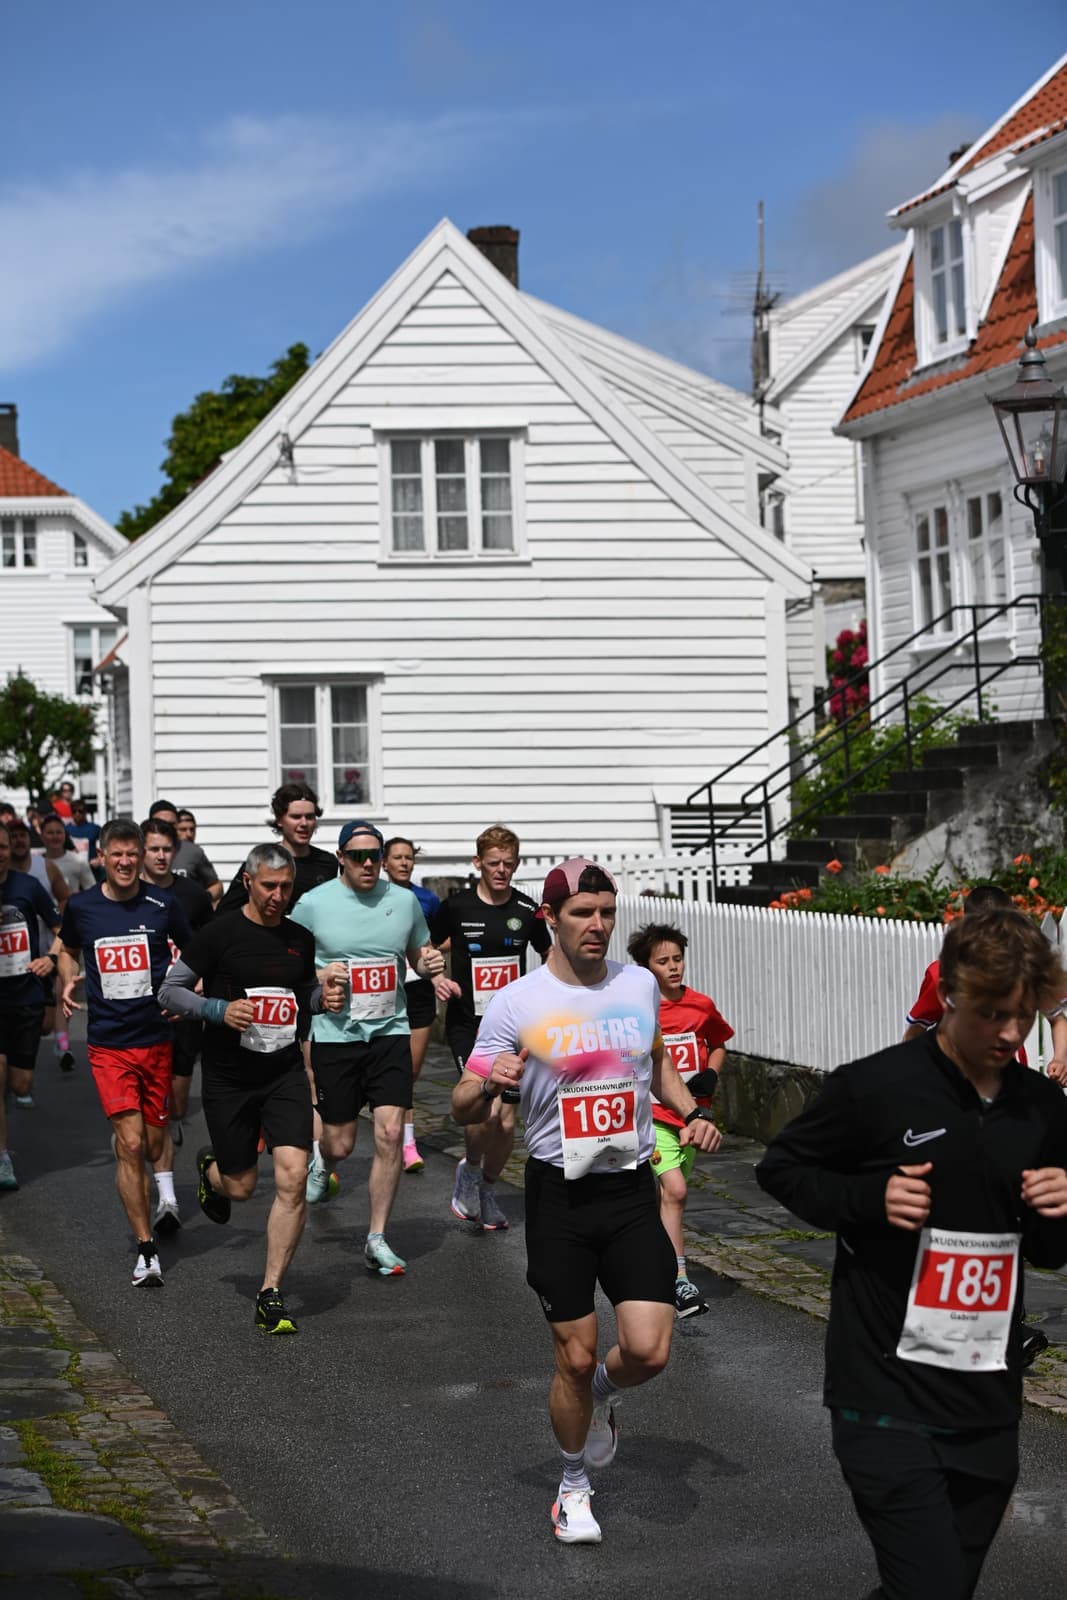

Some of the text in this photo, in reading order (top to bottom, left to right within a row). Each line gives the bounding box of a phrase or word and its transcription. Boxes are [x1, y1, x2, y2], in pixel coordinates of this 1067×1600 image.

[103, 946, 142, 970] 216
[358, 967, 389, 990] 181
[480, 966, 511, 988] 271
[255, 998, 291, 1022] 176
[546, 1016, 641, 1059] 226ERS
[563, 1081, 633, 1094] SKUDENESHAVNLØPET
[573, 1096, 626, 1133] 163
[936, 1256, 1003, 1306] 185
